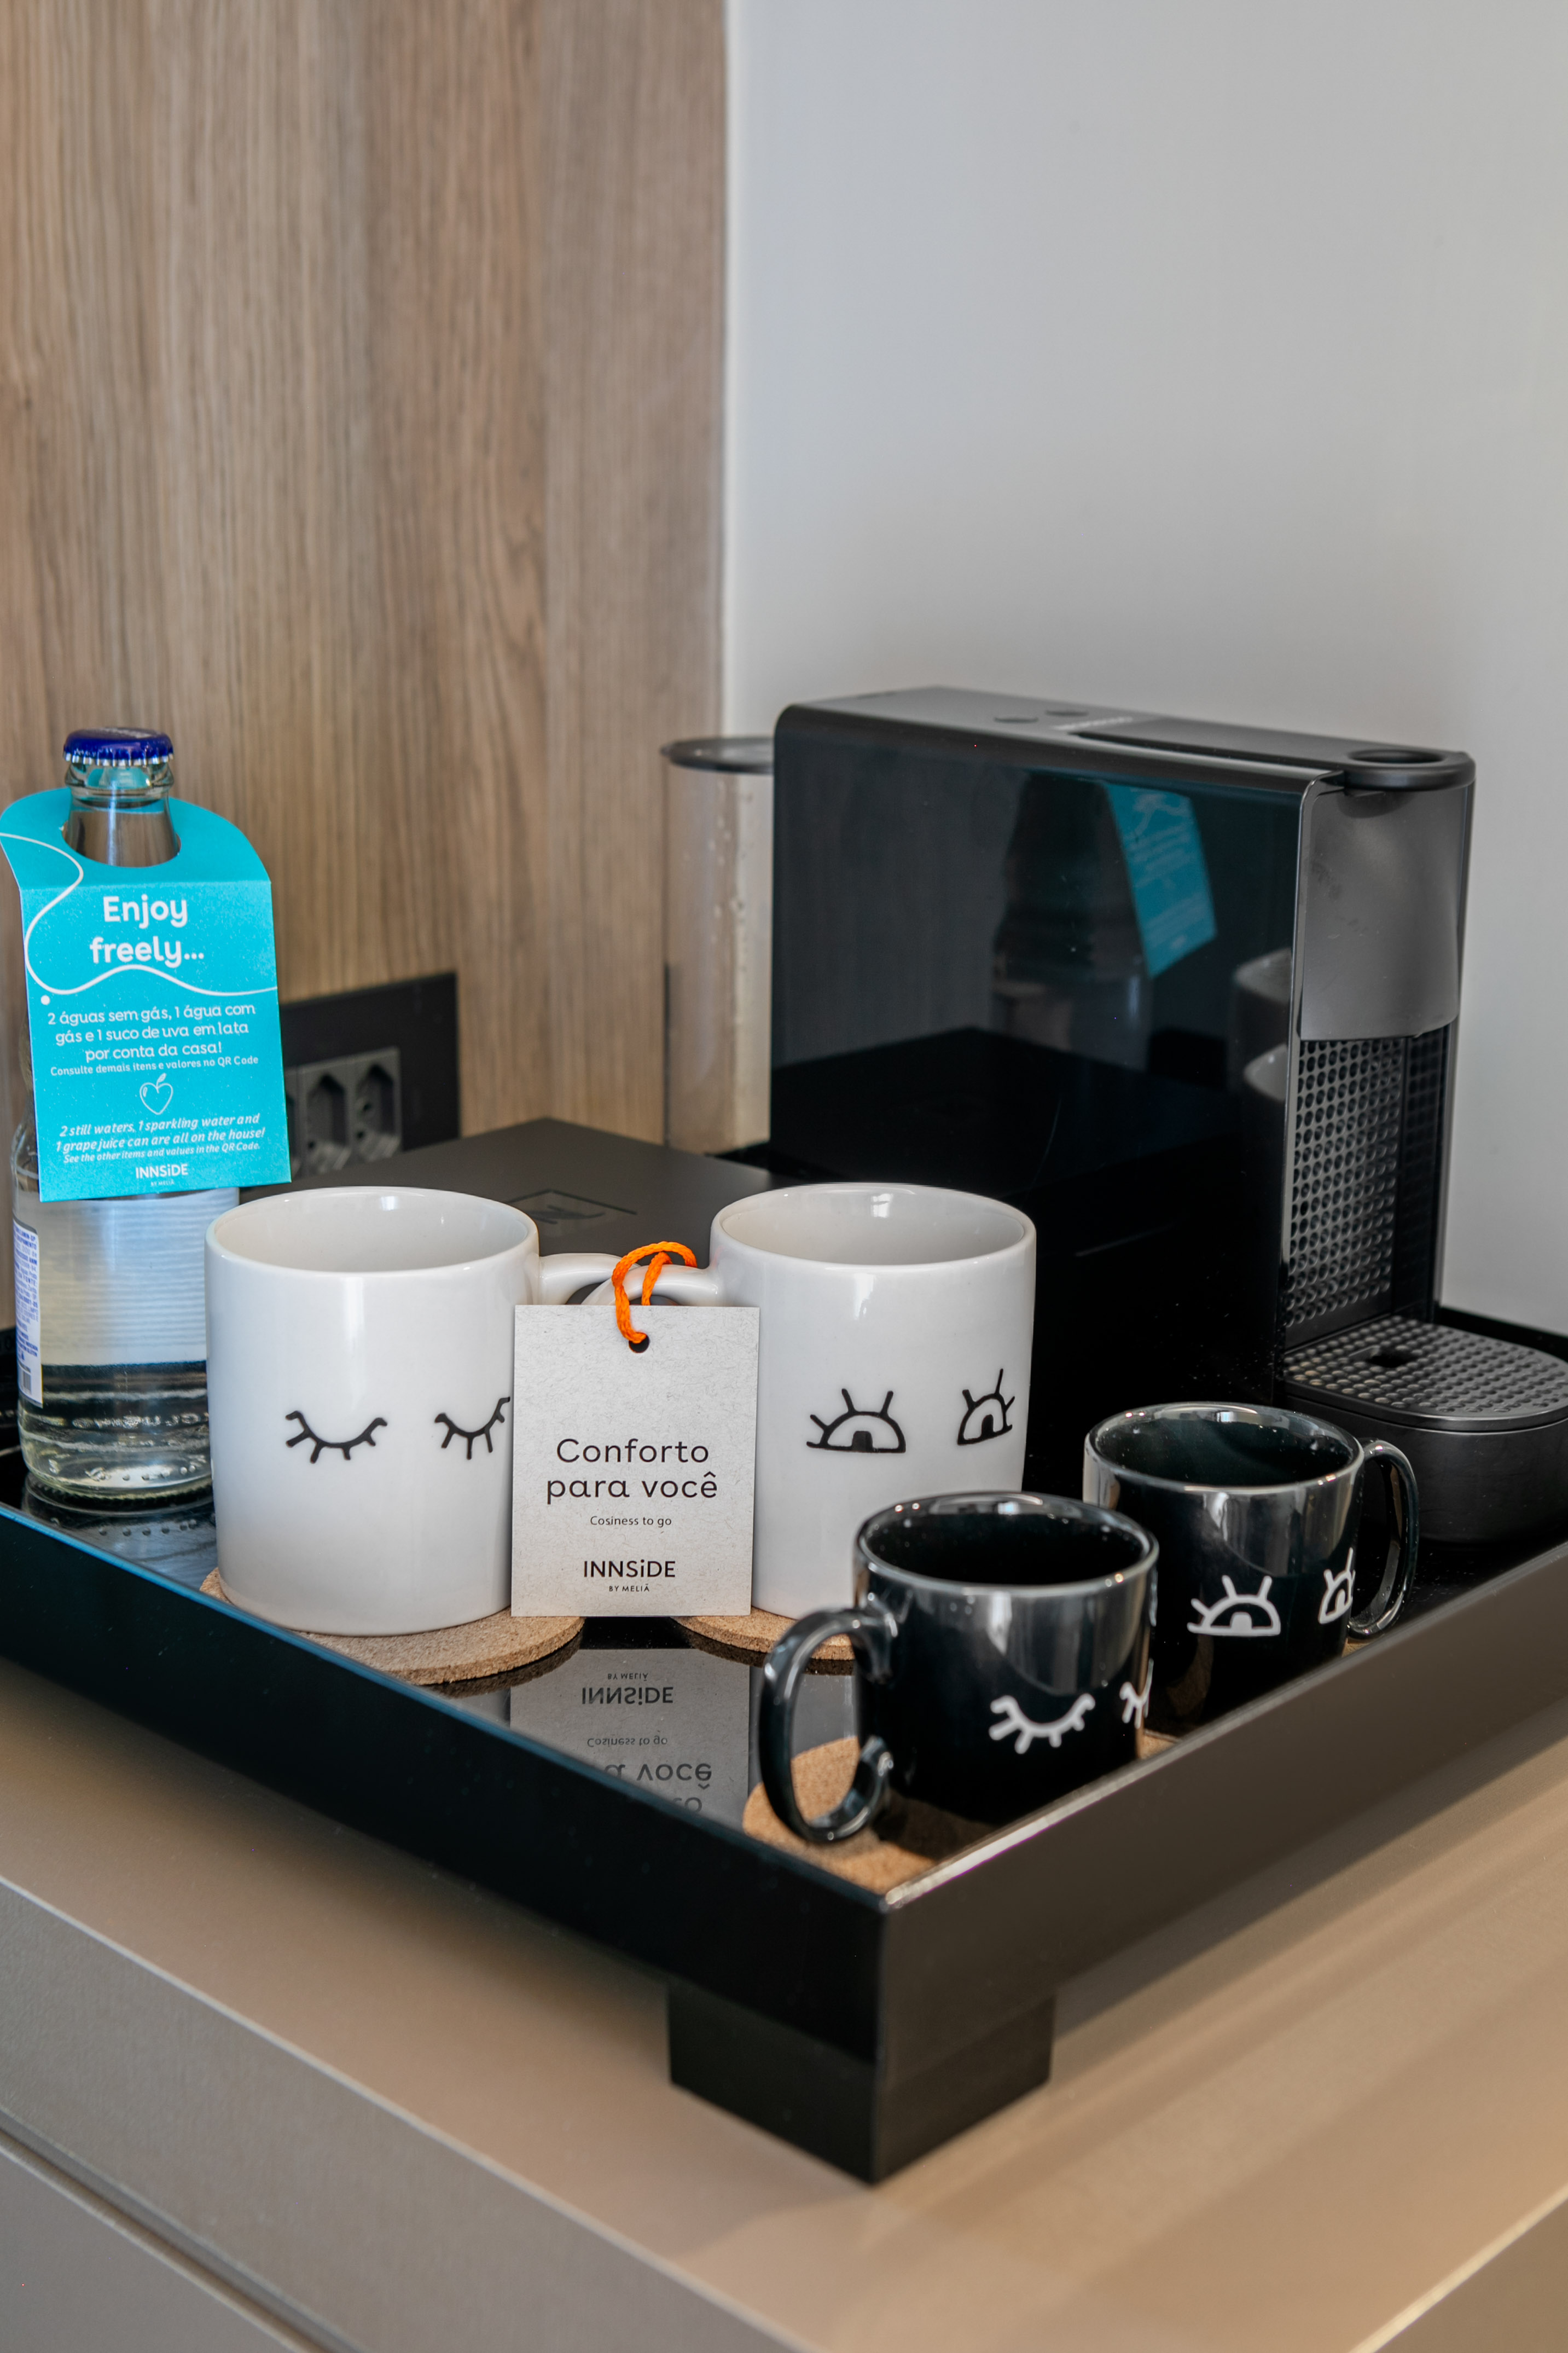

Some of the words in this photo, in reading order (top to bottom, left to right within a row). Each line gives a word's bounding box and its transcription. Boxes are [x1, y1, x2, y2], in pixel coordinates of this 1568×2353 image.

[103, 894, 188, 929] Enjoy
[89, 936, 205, 969] freely...
[48, 1012, 56, 1025] 2
[59, 1011, 106, 1027] águas
[108, 1010, 139, 1022] sem
[141, 1006, 172, 1023] gás,
[175, 1006, 180, 1018] 1
[183, 1005, 222, 1021] água
[225, 1005, 256, 1016] com
[55, 1029, 83, 1046] gás
[85, 1031, 95, 1042] e
[97, 1029, 102, 1041] 1
[106, 1029, 140, 1041] suco
[142, 1025, 160, 1039] de
[162, 1026, 189, 1038] uva
[193, 1025, 216, 1036] em
[217, 1021, 249, 1035] lata
[85, 1049, 110, 1064] por
[113, 1045, 155, 1059] conta
[158, 1043, 178, 1057] da
[182, 1041, 222, 1055] casa!
[50, 1065, 94, 1076] Consulte
[96, 1063, 131, 1074] demais
[132, 1062, 157, 1071] itens
[165, 1059, 202, 1069] valores
[217, 1056, 232, 1068] QR
[234, 1055, 259, 1065] Code
[59, 1125, 68, 1137] 2
[68, 1123, 92, 1137] still
[94, 1123, 136, 1134] waters,
[138, 1120, 144, 1132] 1
[144, 1117, 199, 1133] sparkling
[201, 1116, 236, 1127] water
[237, 1112, 261, 1125] and
[56, 1141, 62, 1152] 1
[62, 1141, 97, 1155] grape
[97, 1138, 125, 1152] juice
[127, 1137, 149, 1147] can
[151, 1135, 171, 1145] are
[172, 1132, 189, 1144] all
[190, 1133, 205, 1143] on
[207, 1130, 227, 1141] the
[228, 1127, 266, 1140] house!
[63, 1154, 79, 1163] See
[81, 1152, 95, 1162] the
[96, 1151, 121, 1161] other
[121, 1150, 146, 1159] items
[147, 1147, 165, 1157] and
[165, 1146, 195, 1156] values
[196, 1145, 205, 1154] in
[206, 1144, 219, 1153] the
[221, 1143, 235, 1153] QR
[236, 1141, 260, 1151] Code.
[135, 1163, 189, 1179] INNSiDE
[556, 1438, 710, 1464] Conforto
[546, 1479, 630, 1505] para
[641, 1471, 718, 1498] você
[590, 1515, 639, 1526] Cosiness
[642, 1517, 654, 1526] to
[657, 1517, 672, 1528] go
[583, 1559, 676, 1579] INNSiDE
